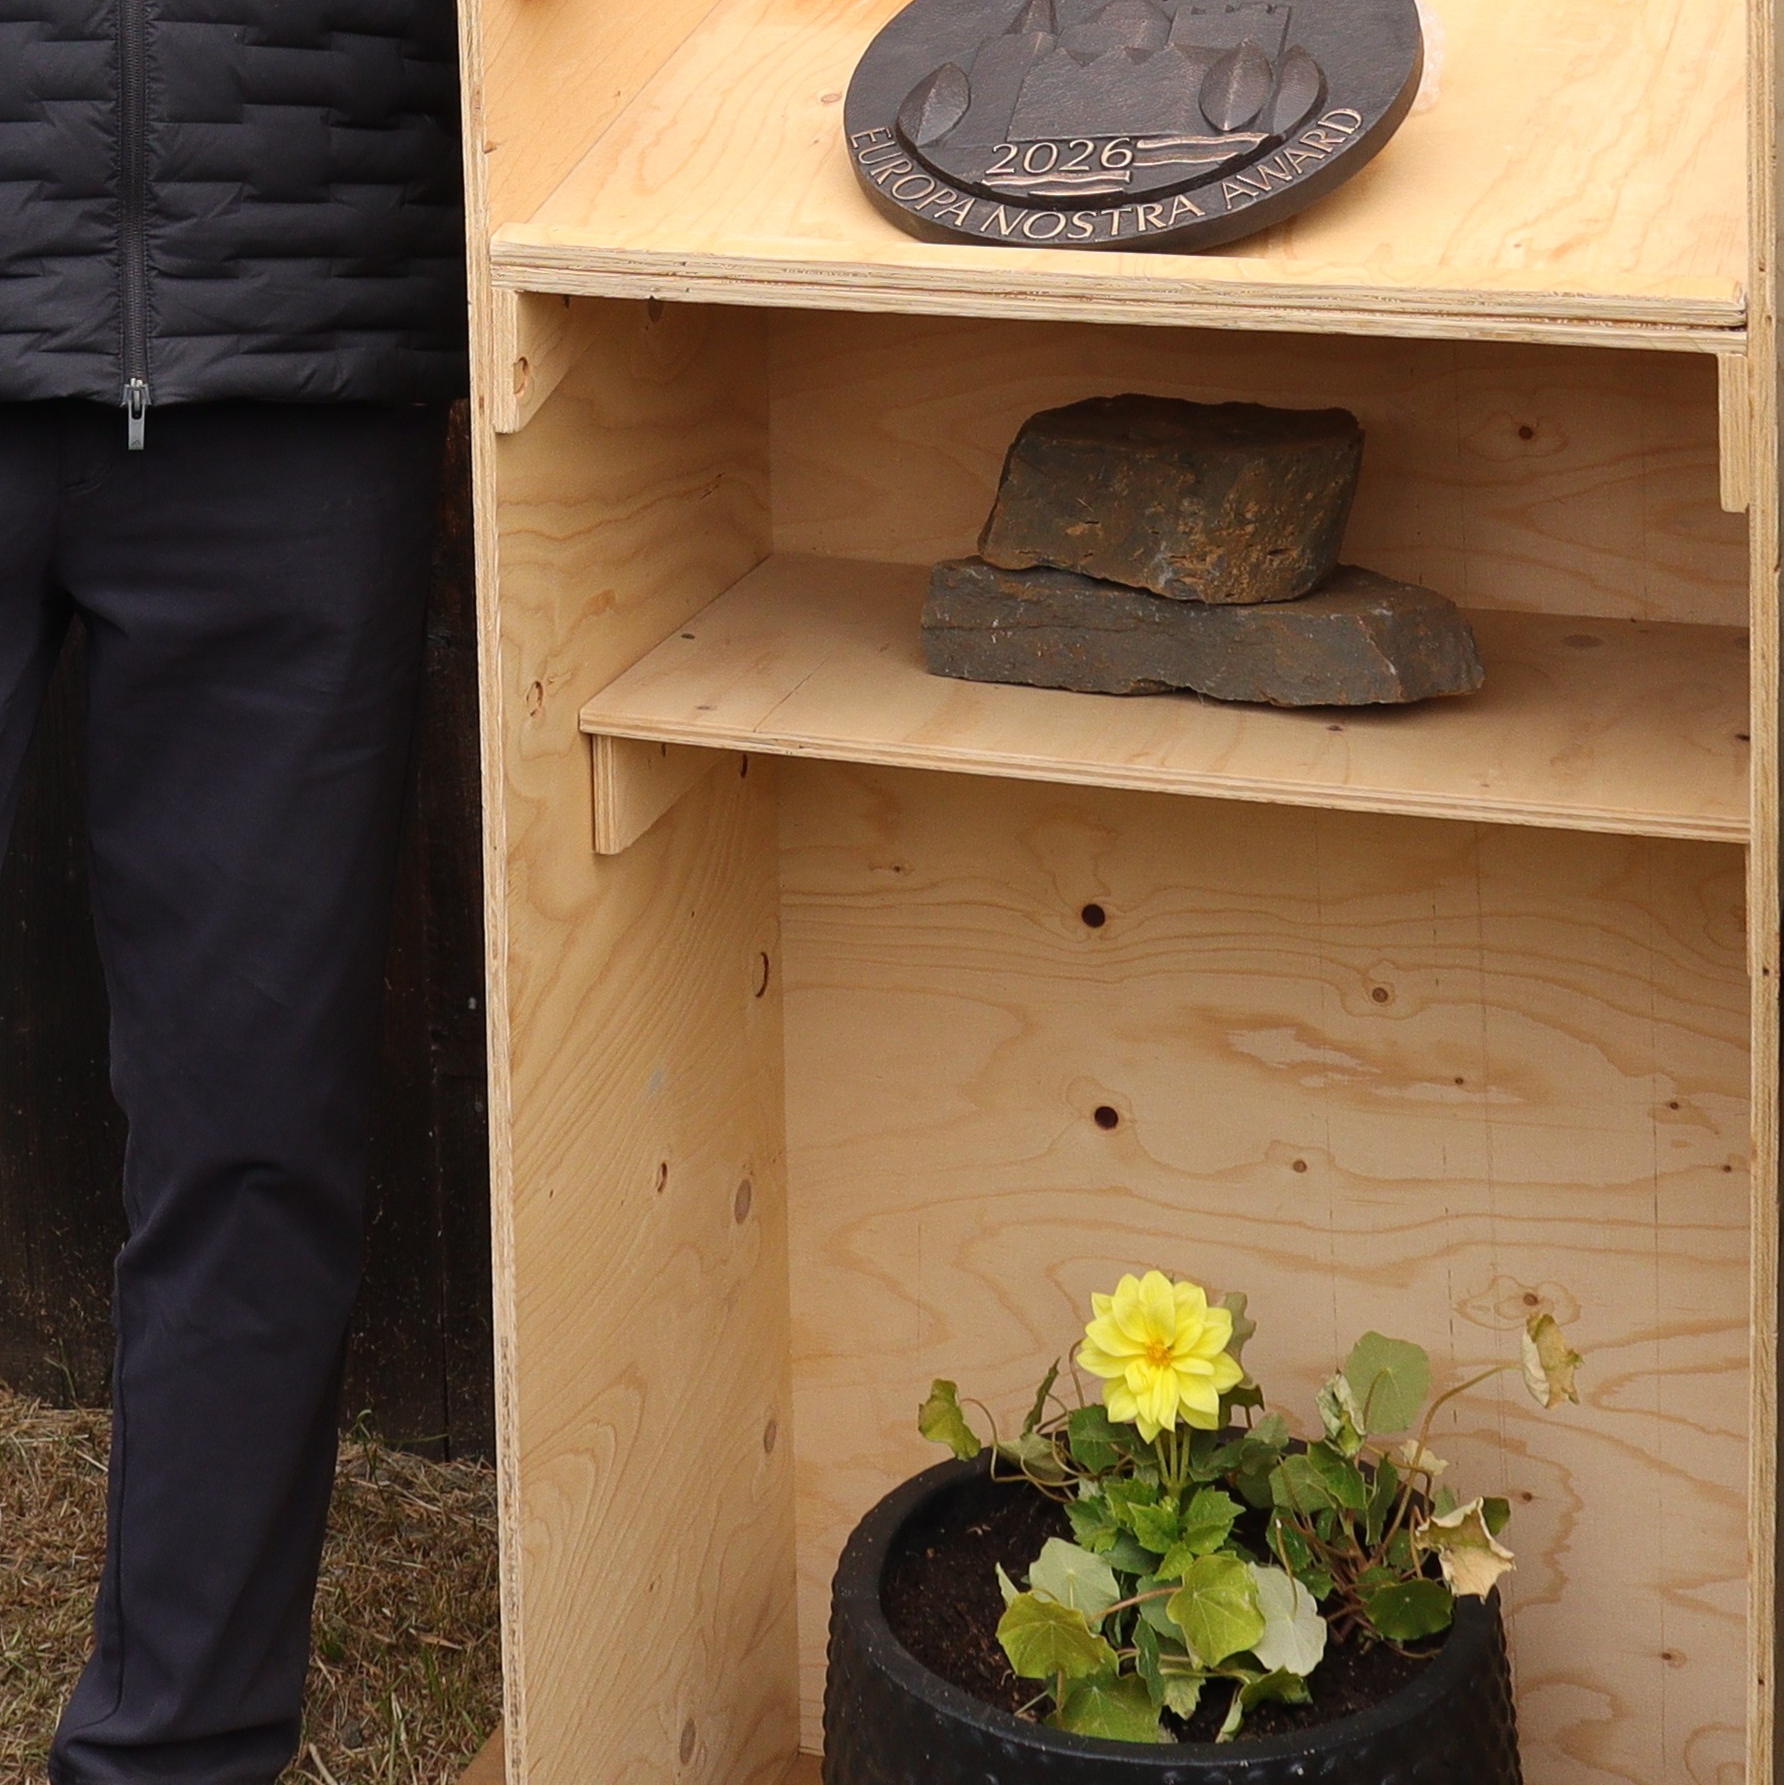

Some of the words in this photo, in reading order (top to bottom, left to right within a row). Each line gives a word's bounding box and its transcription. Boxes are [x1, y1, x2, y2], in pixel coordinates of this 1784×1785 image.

[849, 127, 976, 227] EUROPA
[980, 195, 1206, 239] NOSTRA
[1221, 107, 1363, 211] AWARD
[985, 137, 1133, 175] 2026
